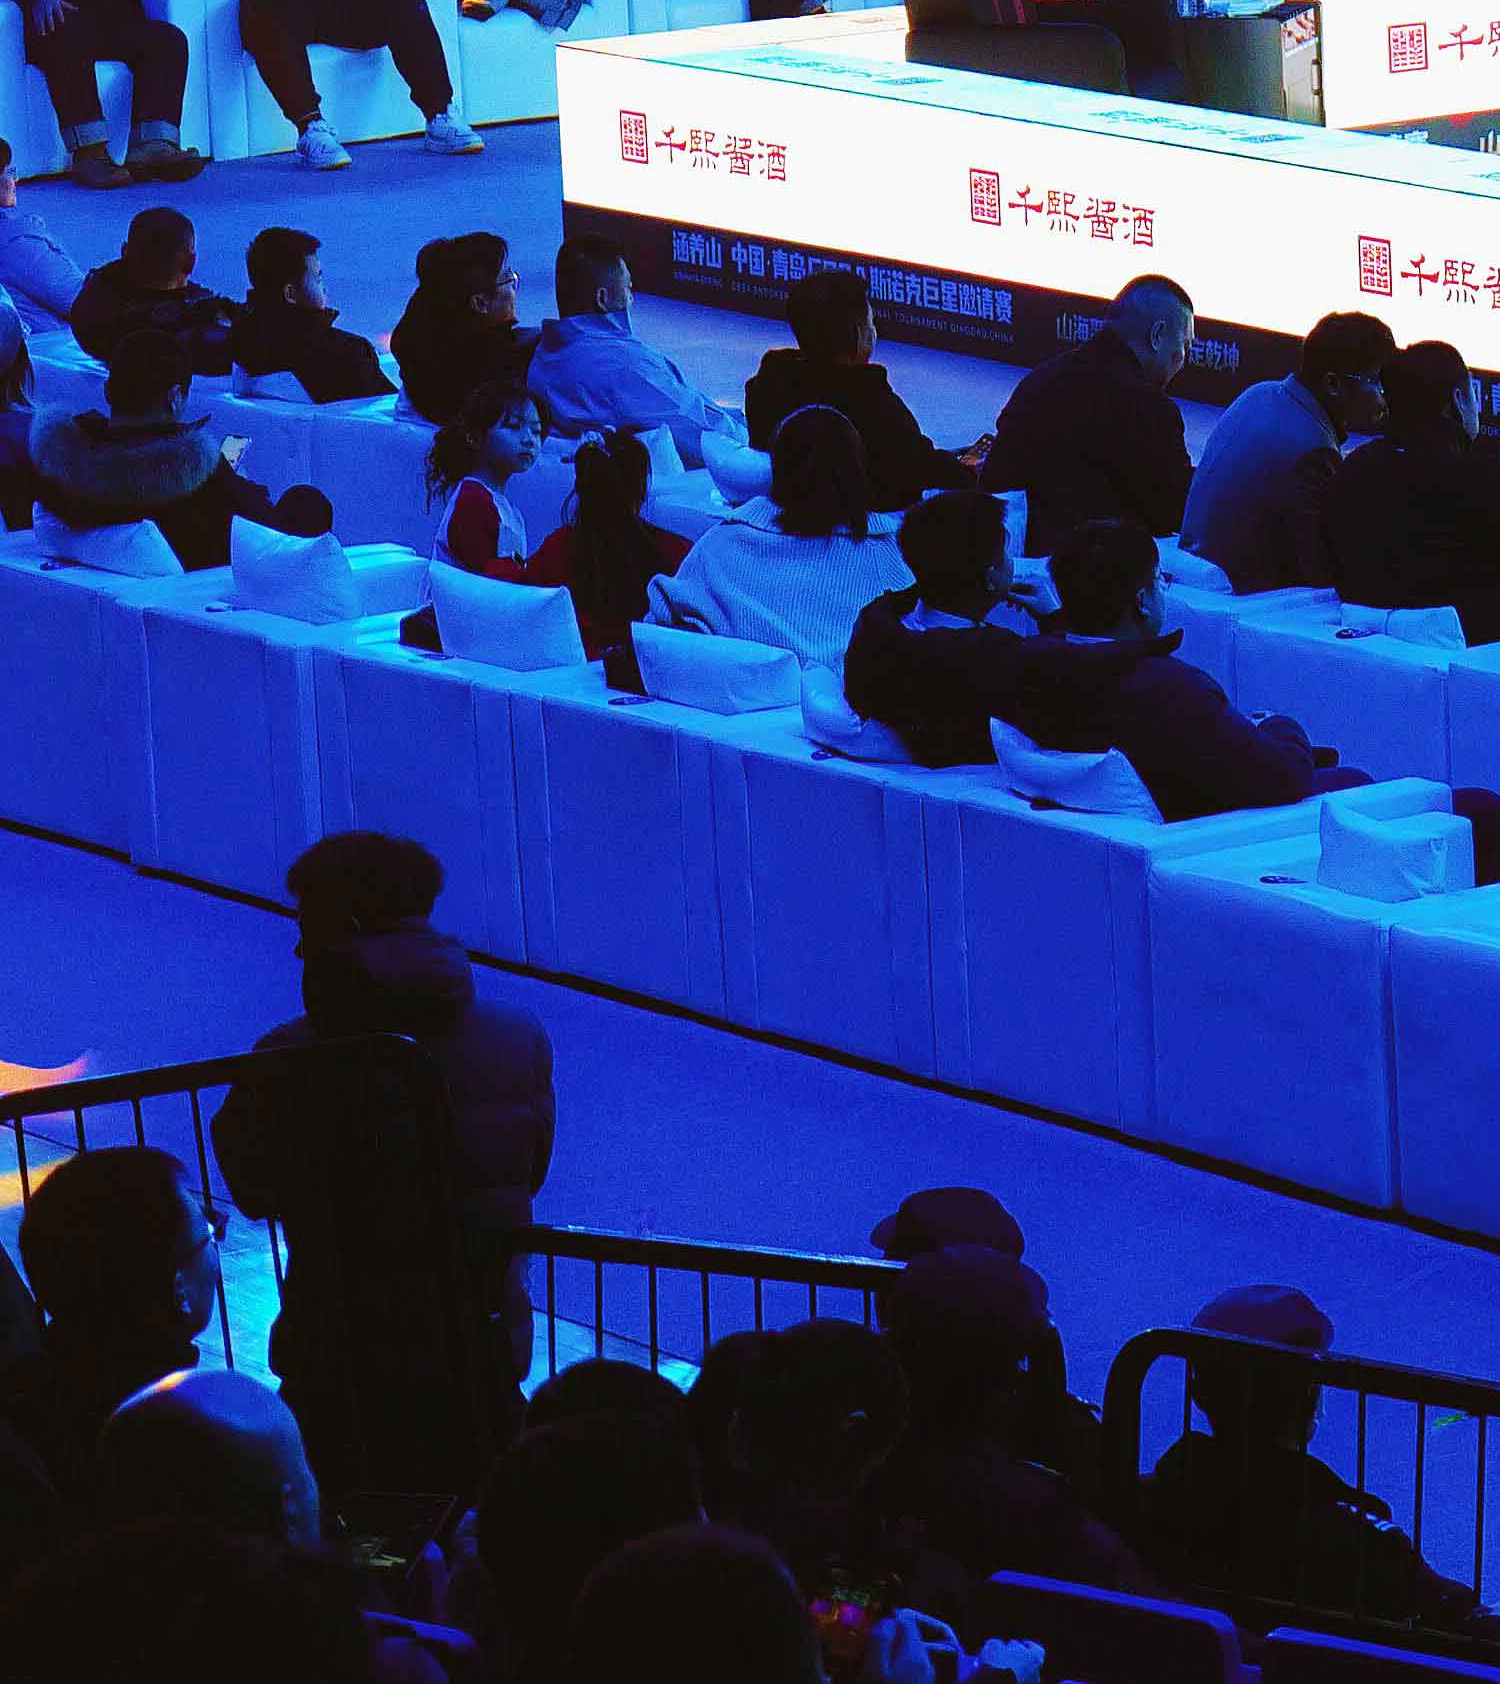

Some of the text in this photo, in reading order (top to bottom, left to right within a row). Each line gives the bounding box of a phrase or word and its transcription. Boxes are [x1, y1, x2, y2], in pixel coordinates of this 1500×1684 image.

[654, 124, 788, 183] 千熙酱酒
[1007, 183, 1157, 248] 千熙酱酒
[671, 229, 723, 269] 涵养山
